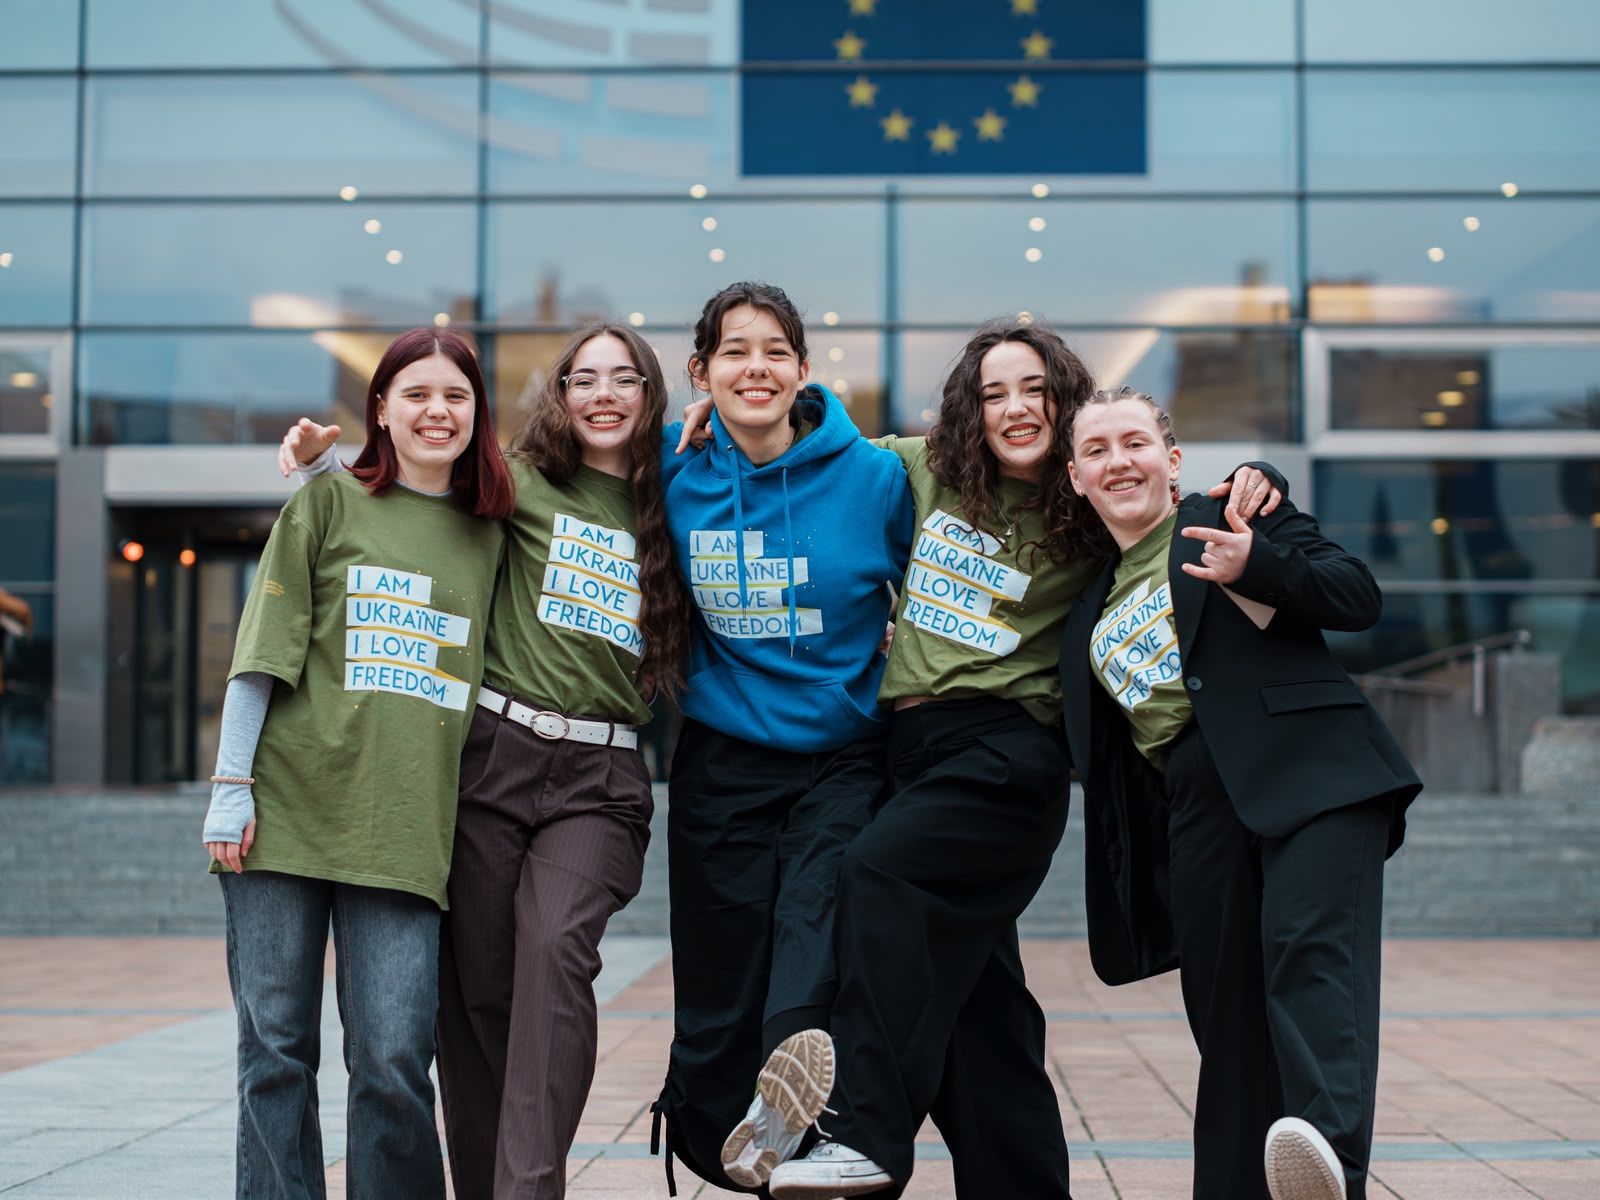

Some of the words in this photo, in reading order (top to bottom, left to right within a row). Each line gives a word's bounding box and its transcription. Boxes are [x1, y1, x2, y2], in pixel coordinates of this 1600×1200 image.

[562, 517, 568, 533] I
[580, 526, 614, 549] AM
[695, 534, 700, 552] I
[931, 515, 945, 528] I
[946, 526, 985, 547] AM
[559, 542, 639, 582] UKRAÏN
[919, 537, 1009, 590] UKRAÏNE
[356, 569, 361, 590] I
[375, 572, 411, 596] AM
[551, 569, 558, 589] I
[568, 574, 628, 612] LOVE
[699, 590, 706, 606] I
[909, 567, 917, 587] I
[920, 572, 979, 610] LOVE
[356, 601, 449, 637] UKRAÏNE
[545, 600, 645, 653] FREEDOM
[908, 598, 998, 648] REEDOM
[1096, 588, 1169, 658] UKRAÏNE
[1096, 622, 1102, 635] I
[354, 634, 359, 654] I
[371, 634, 428, 663] LOVE
[1114, 628, 1162, 674] LOVE
[352, 666, 447, 703] FREEDOM
[1109, 668, 1122, 684] I
[1126, 652, 1181, 705] FREEDO
